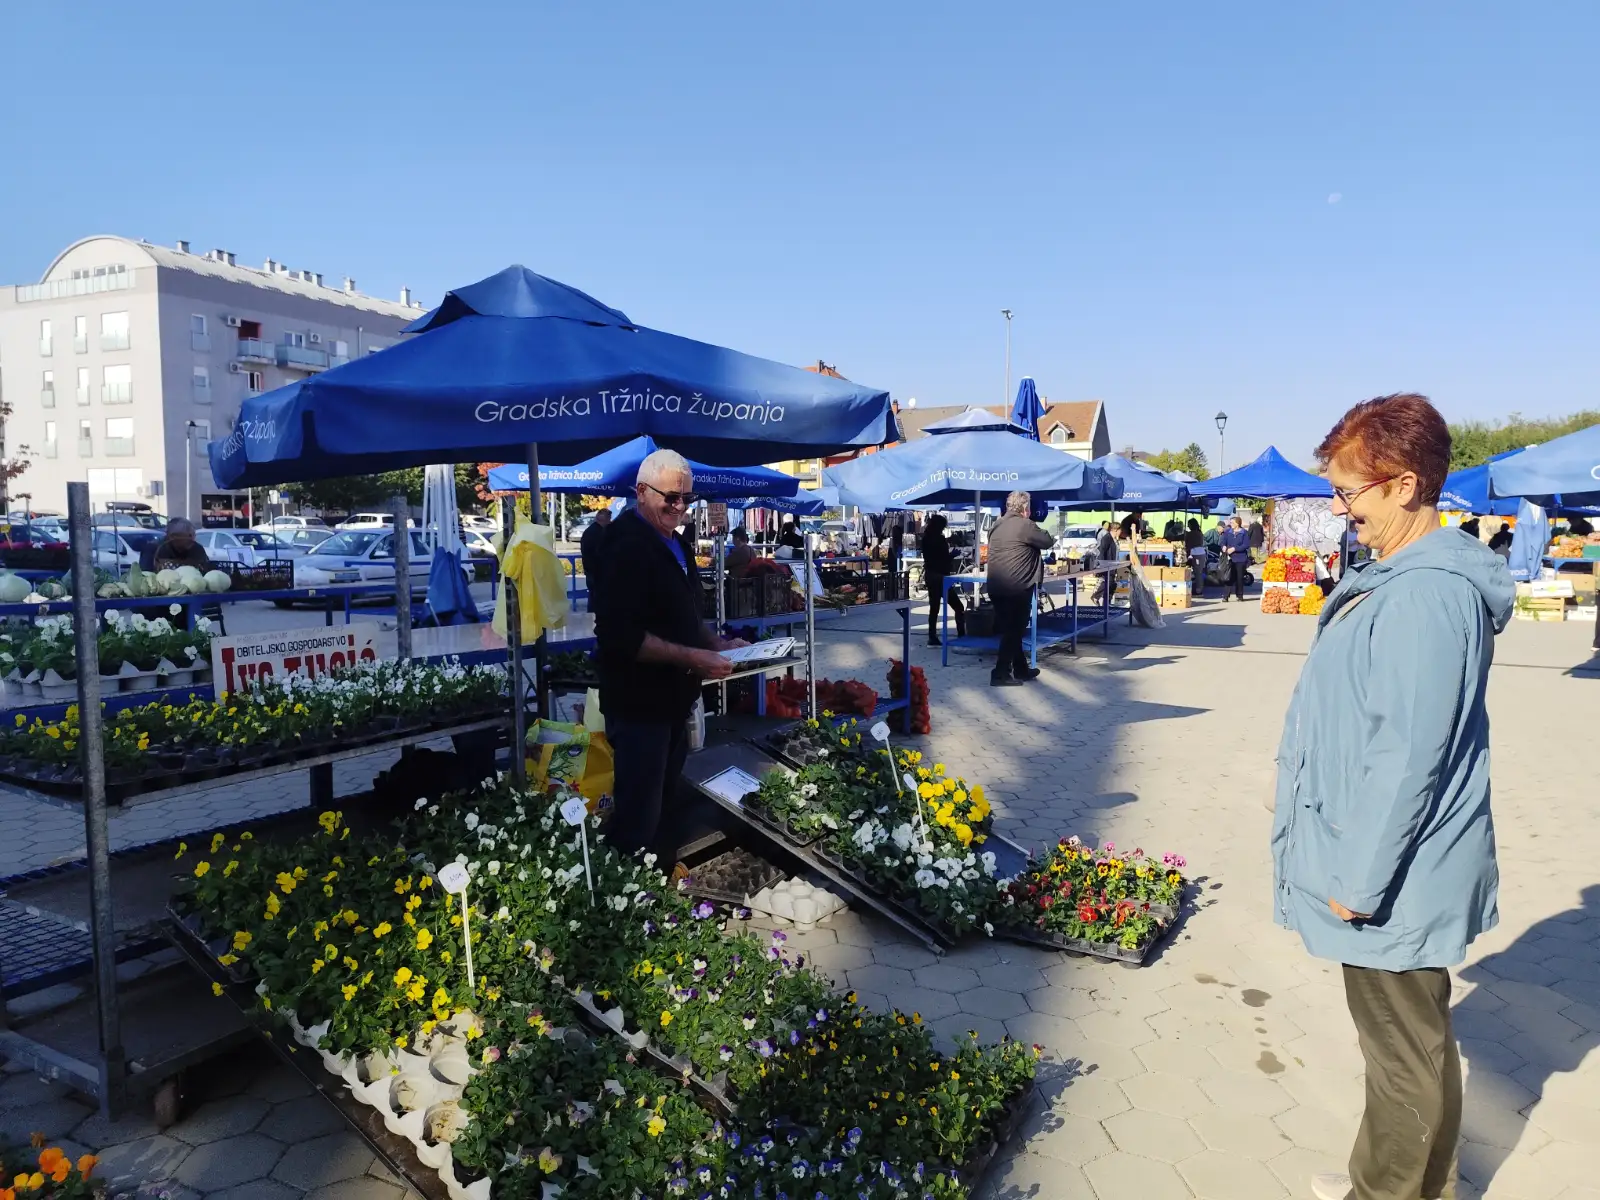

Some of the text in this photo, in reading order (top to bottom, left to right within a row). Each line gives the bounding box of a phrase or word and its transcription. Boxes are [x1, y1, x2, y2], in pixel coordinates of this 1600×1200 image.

[474, 387, 785, 425] Gradska Tržnica Županja
[548, 470, 572, 480] Tržnica
[573, 469, 604, 482] Županja
[692, 473, 717, 484] radska
[717, 474, 741, 486] Tržnica
[930, 467, 966, 484] Tržnica
[968, 468, 1019, 483] Županja
[236, 642, 287, 658] OBITELJSKO
[288, 635, 347, 652] GOSPODARSTVO
